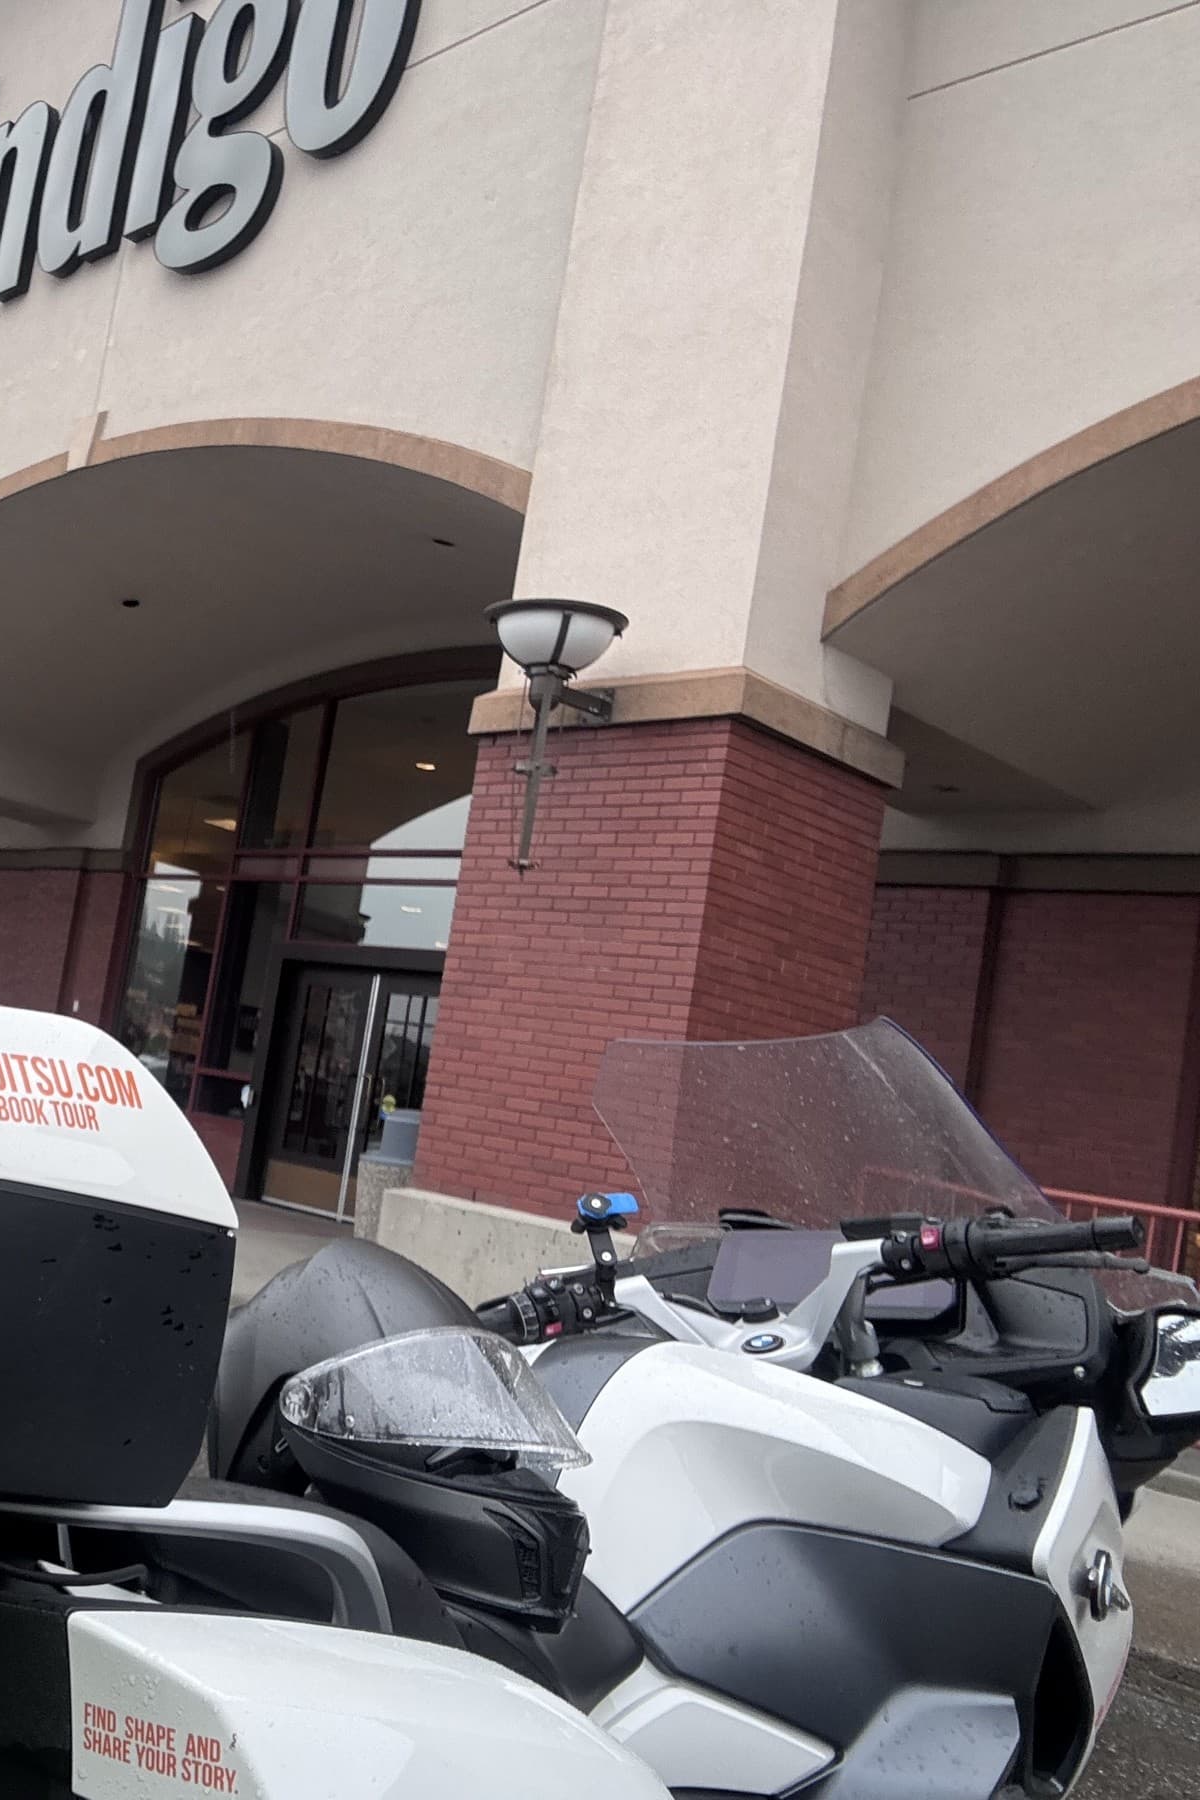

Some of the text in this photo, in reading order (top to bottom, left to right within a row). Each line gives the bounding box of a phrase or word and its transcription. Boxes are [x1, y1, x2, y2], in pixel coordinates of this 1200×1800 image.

[49, 1099, 100, 1131] TOUR
[83, 1727, 239, 1795] SHARE YOUR STORY.
[84, 1702, 221, 1763] FIND SHAPE AND
